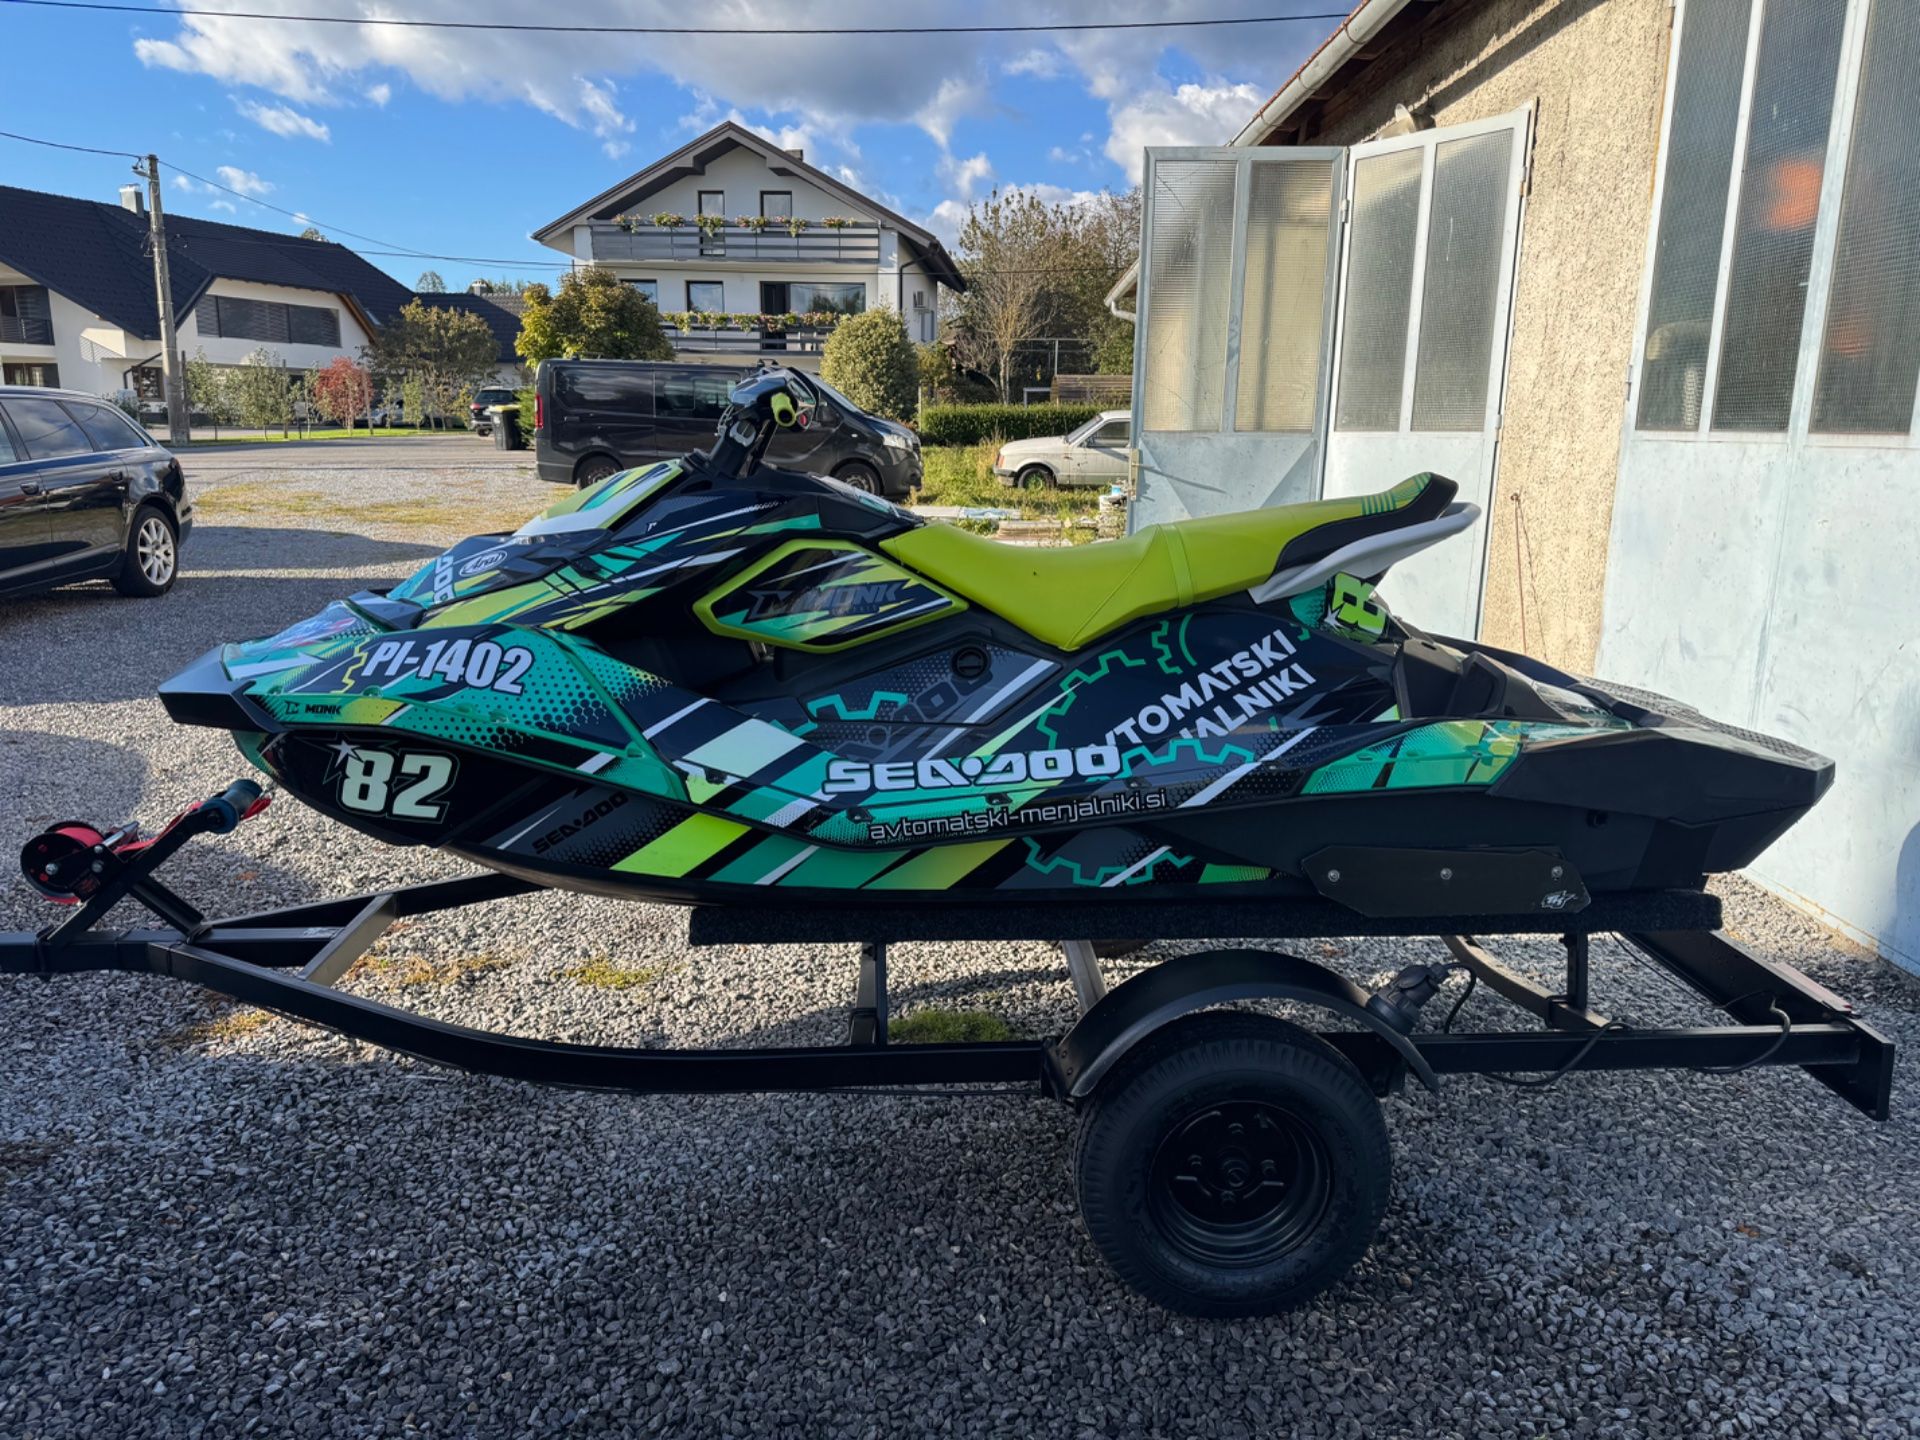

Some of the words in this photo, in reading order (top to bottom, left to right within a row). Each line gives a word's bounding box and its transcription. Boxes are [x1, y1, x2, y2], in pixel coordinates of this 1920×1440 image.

[361, 639, 533, 695] PI-1402
[304, 703, 343, 716] MONK
[341, 749, 453, 819] 82
[870, 788, 1167, 840] avtomatski-menjalniki.si
